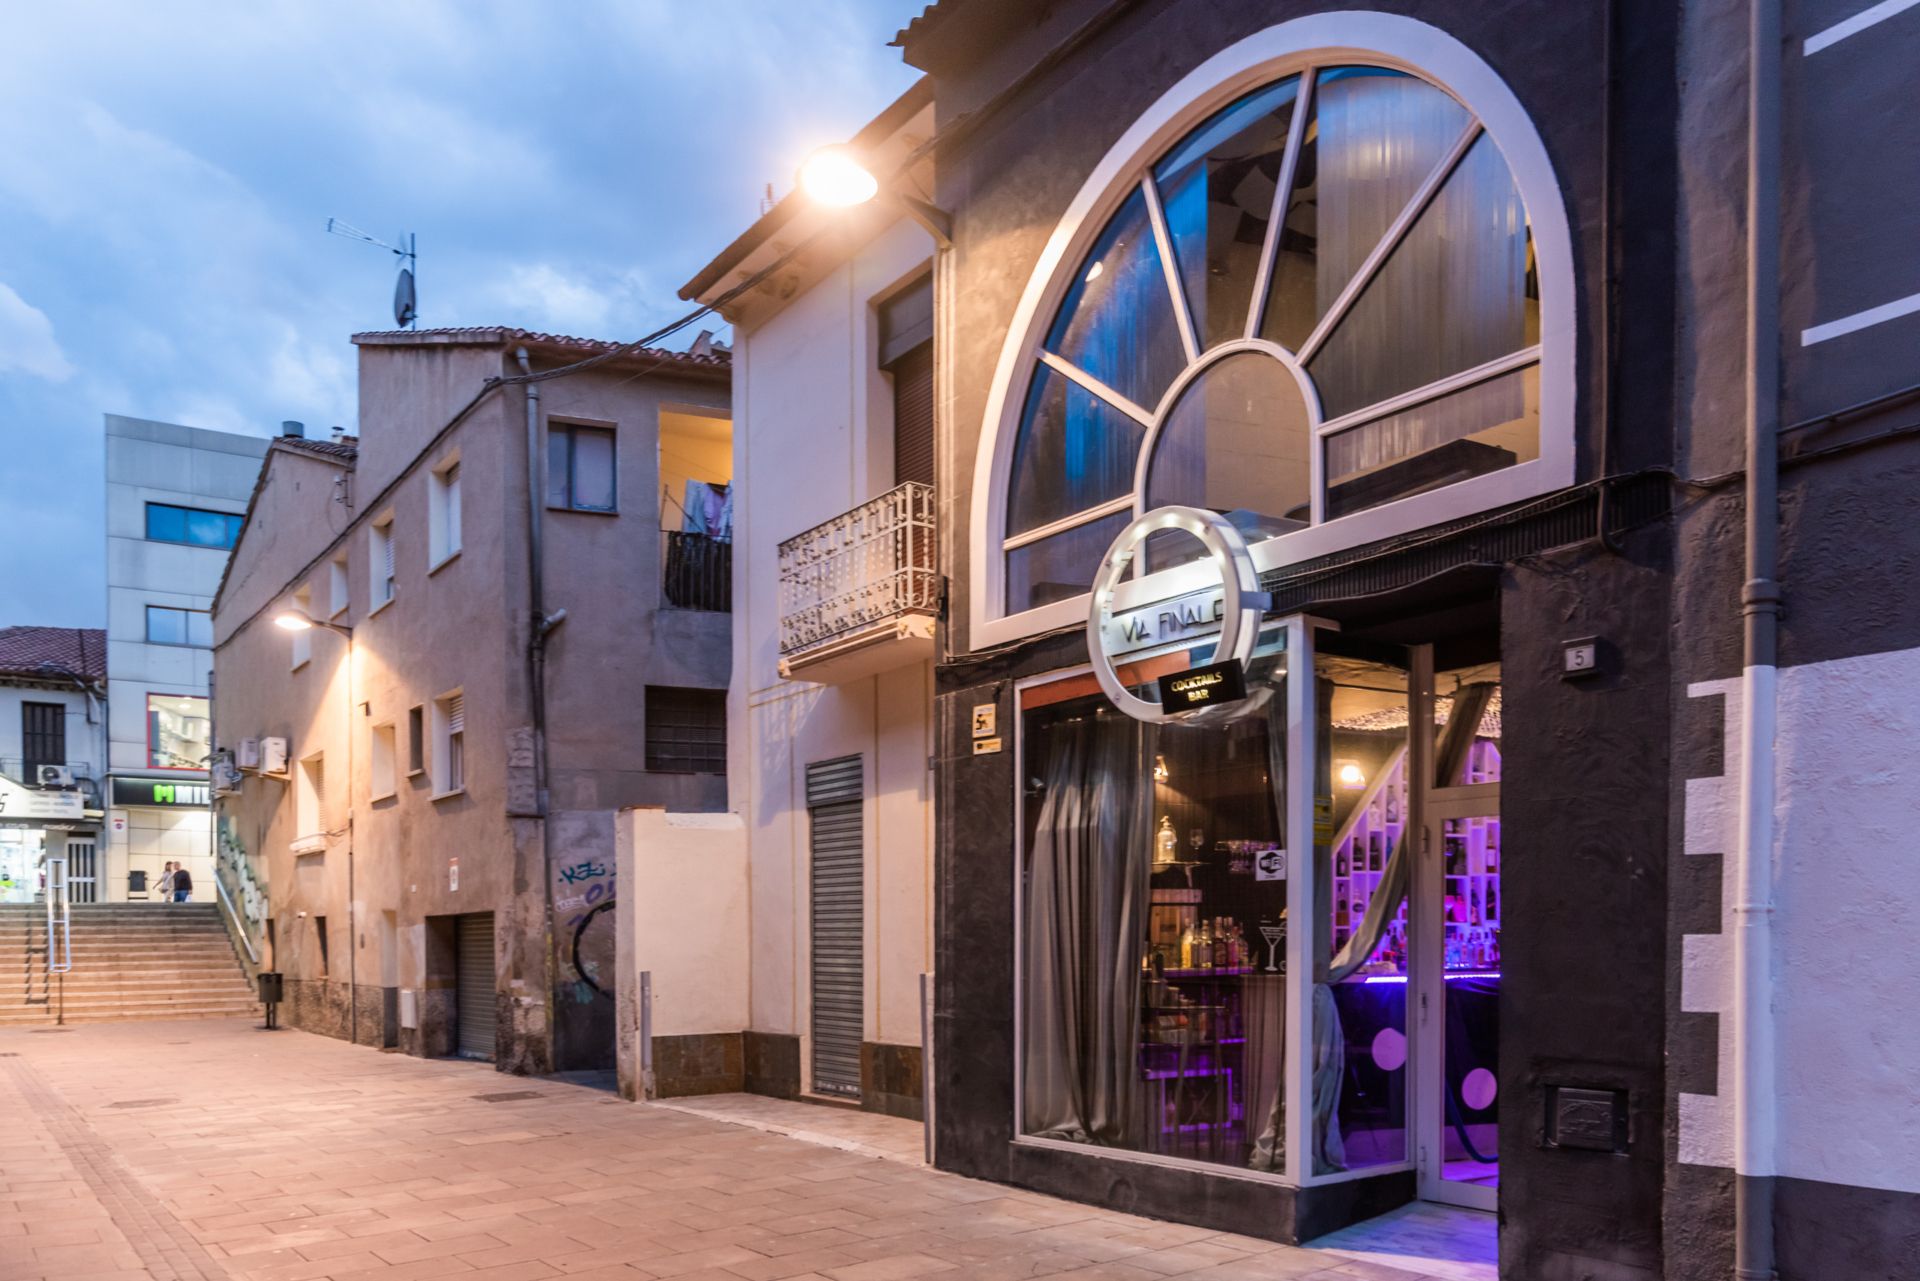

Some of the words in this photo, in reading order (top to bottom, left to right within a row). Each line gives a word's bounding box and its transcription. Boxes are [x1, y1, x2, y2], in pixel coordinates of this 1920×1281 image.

[1121, 615, 1151, 642] VIA
[1574, 649, 1585, 666] 5
[1170, 671, 1224, 692] COCKTAILS
[1187, 689, 1210, 702] BAR
